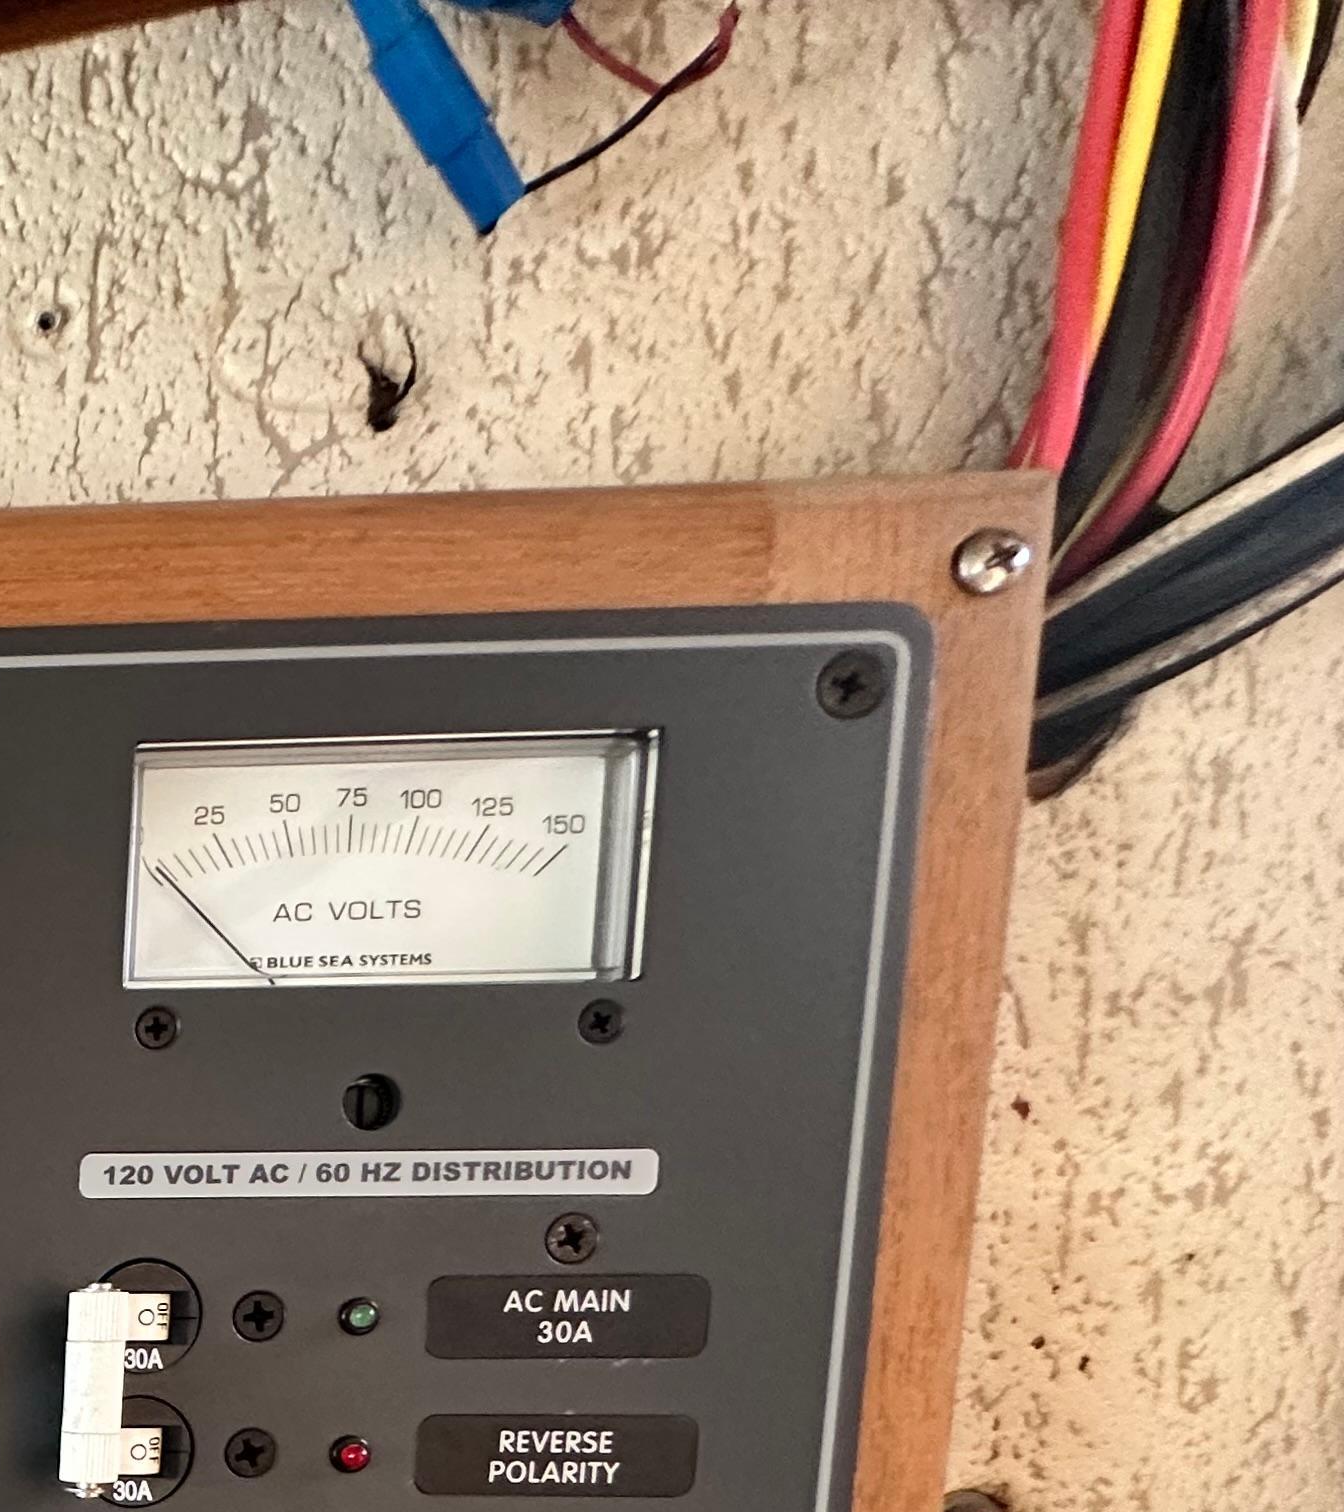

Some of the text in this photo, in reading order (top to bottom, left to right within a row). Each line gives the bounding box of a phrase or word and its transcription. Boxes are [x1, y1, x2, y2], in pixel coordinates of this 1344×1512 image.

[270, 794, 300, 812] 50
[338, 789, 367, 807] 75
[401, 790, 441, 809] 100
[472, 798, 513, 816] 125
[194, 807, 225, 825] 25
[542, 815, 585, 834] 150
[273, 900, 421, 922] AC VOLTS
[267, 954, 432, 968] BLUE SEA SYSTEMS
[104, 1165, 153, 1185] 120
[165, 1164, 239, 1185] VOLT
[250, 1163, 288, 1184] AC
[317, 1163, 351, 1184] 60
[361, 1162, 403, 1182] HZ
[413, 1160, 632, 1182] DISTRIBUTION
[504, 1290, 631, 1313] AC MAIN
[156, 1302, 169, 1331] OFF
[537, 1321, 593, 1344] 30A
[124, 1349, 163, 1370] 30A
[148, 1437, 161, 1466] OFF
[499, 1431, 613, 1454] REVERSE
[488, 1461, 620, 1485] POLARITY
[113, 1481, 152, 1502] 30A
